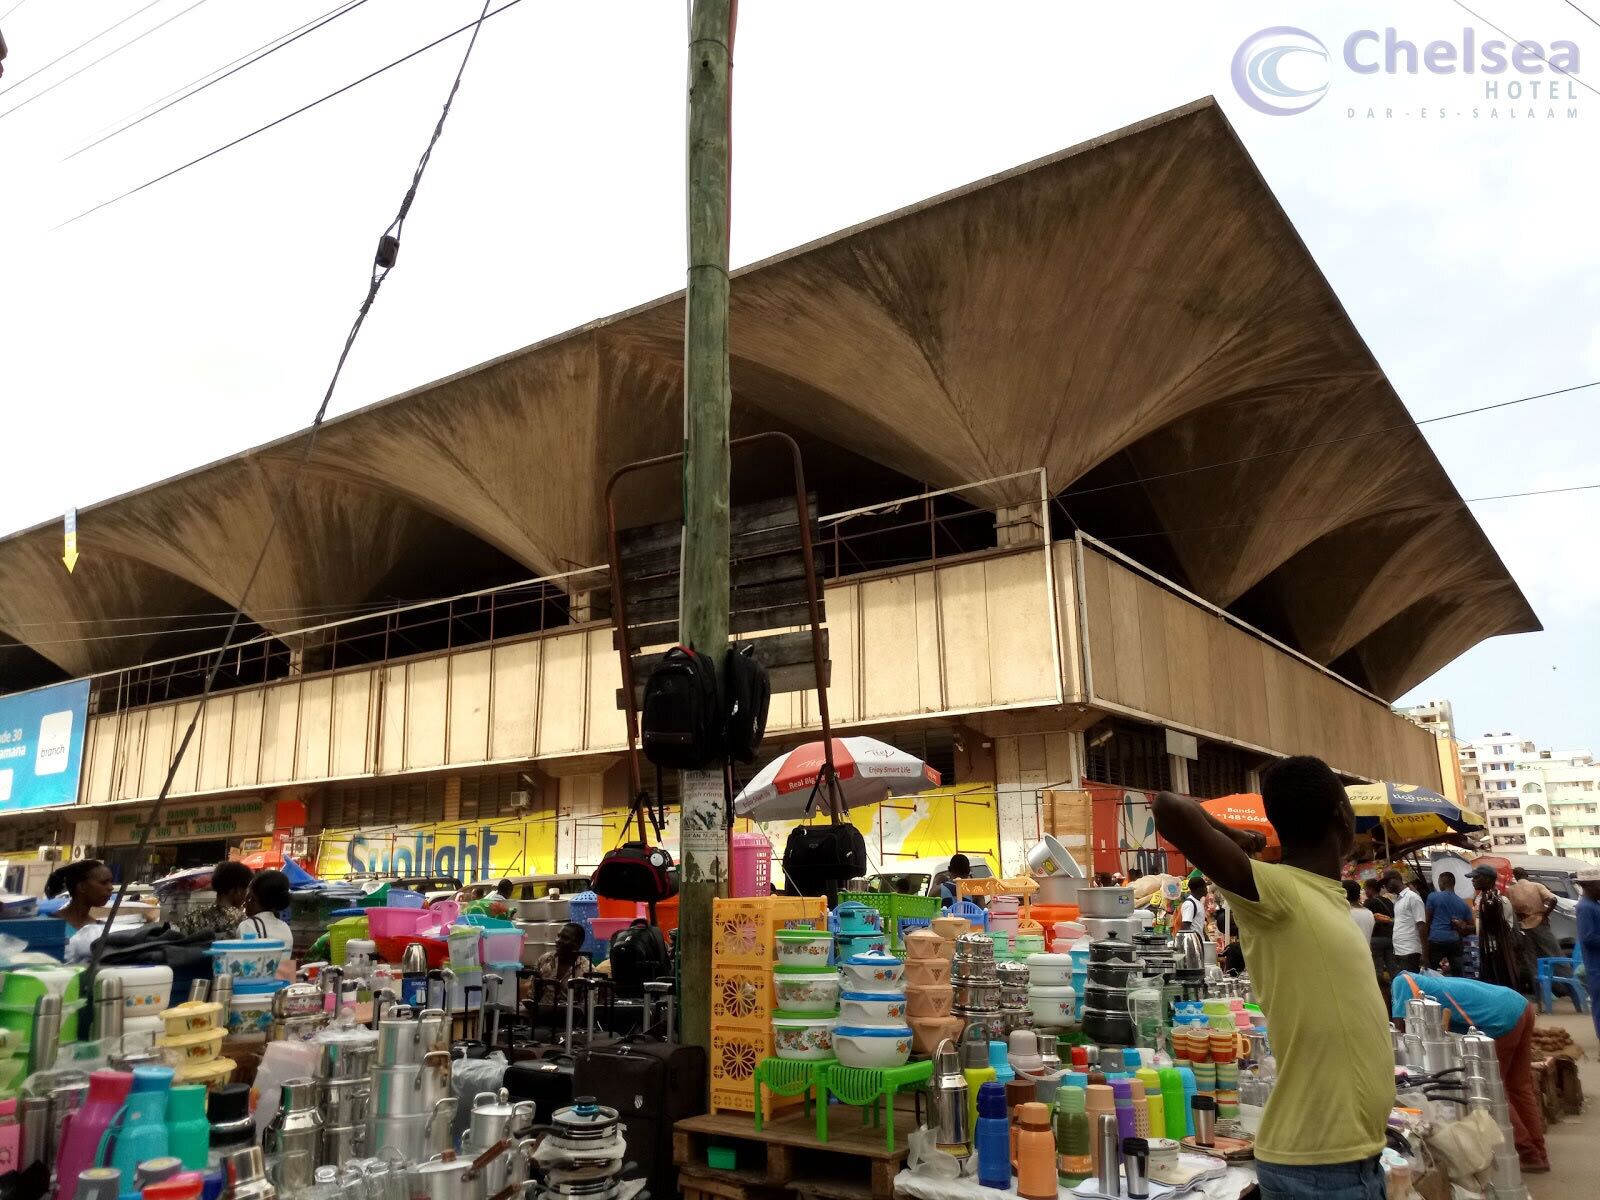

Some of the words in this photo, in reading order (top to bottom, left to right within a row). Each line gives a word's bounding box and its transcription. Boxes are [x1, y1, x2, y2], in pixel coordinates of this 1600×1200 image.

[41, 744, 65, 757] branch
[868, 766, 883, 775] Enjoy
[884, 766, 900, 774] Smart
[901, 766, 911, 774] Life
[788, 778, 804, 790] Real
[804, 776, 816, 785] Big
[347, 826, 498, 882] Sunlight
